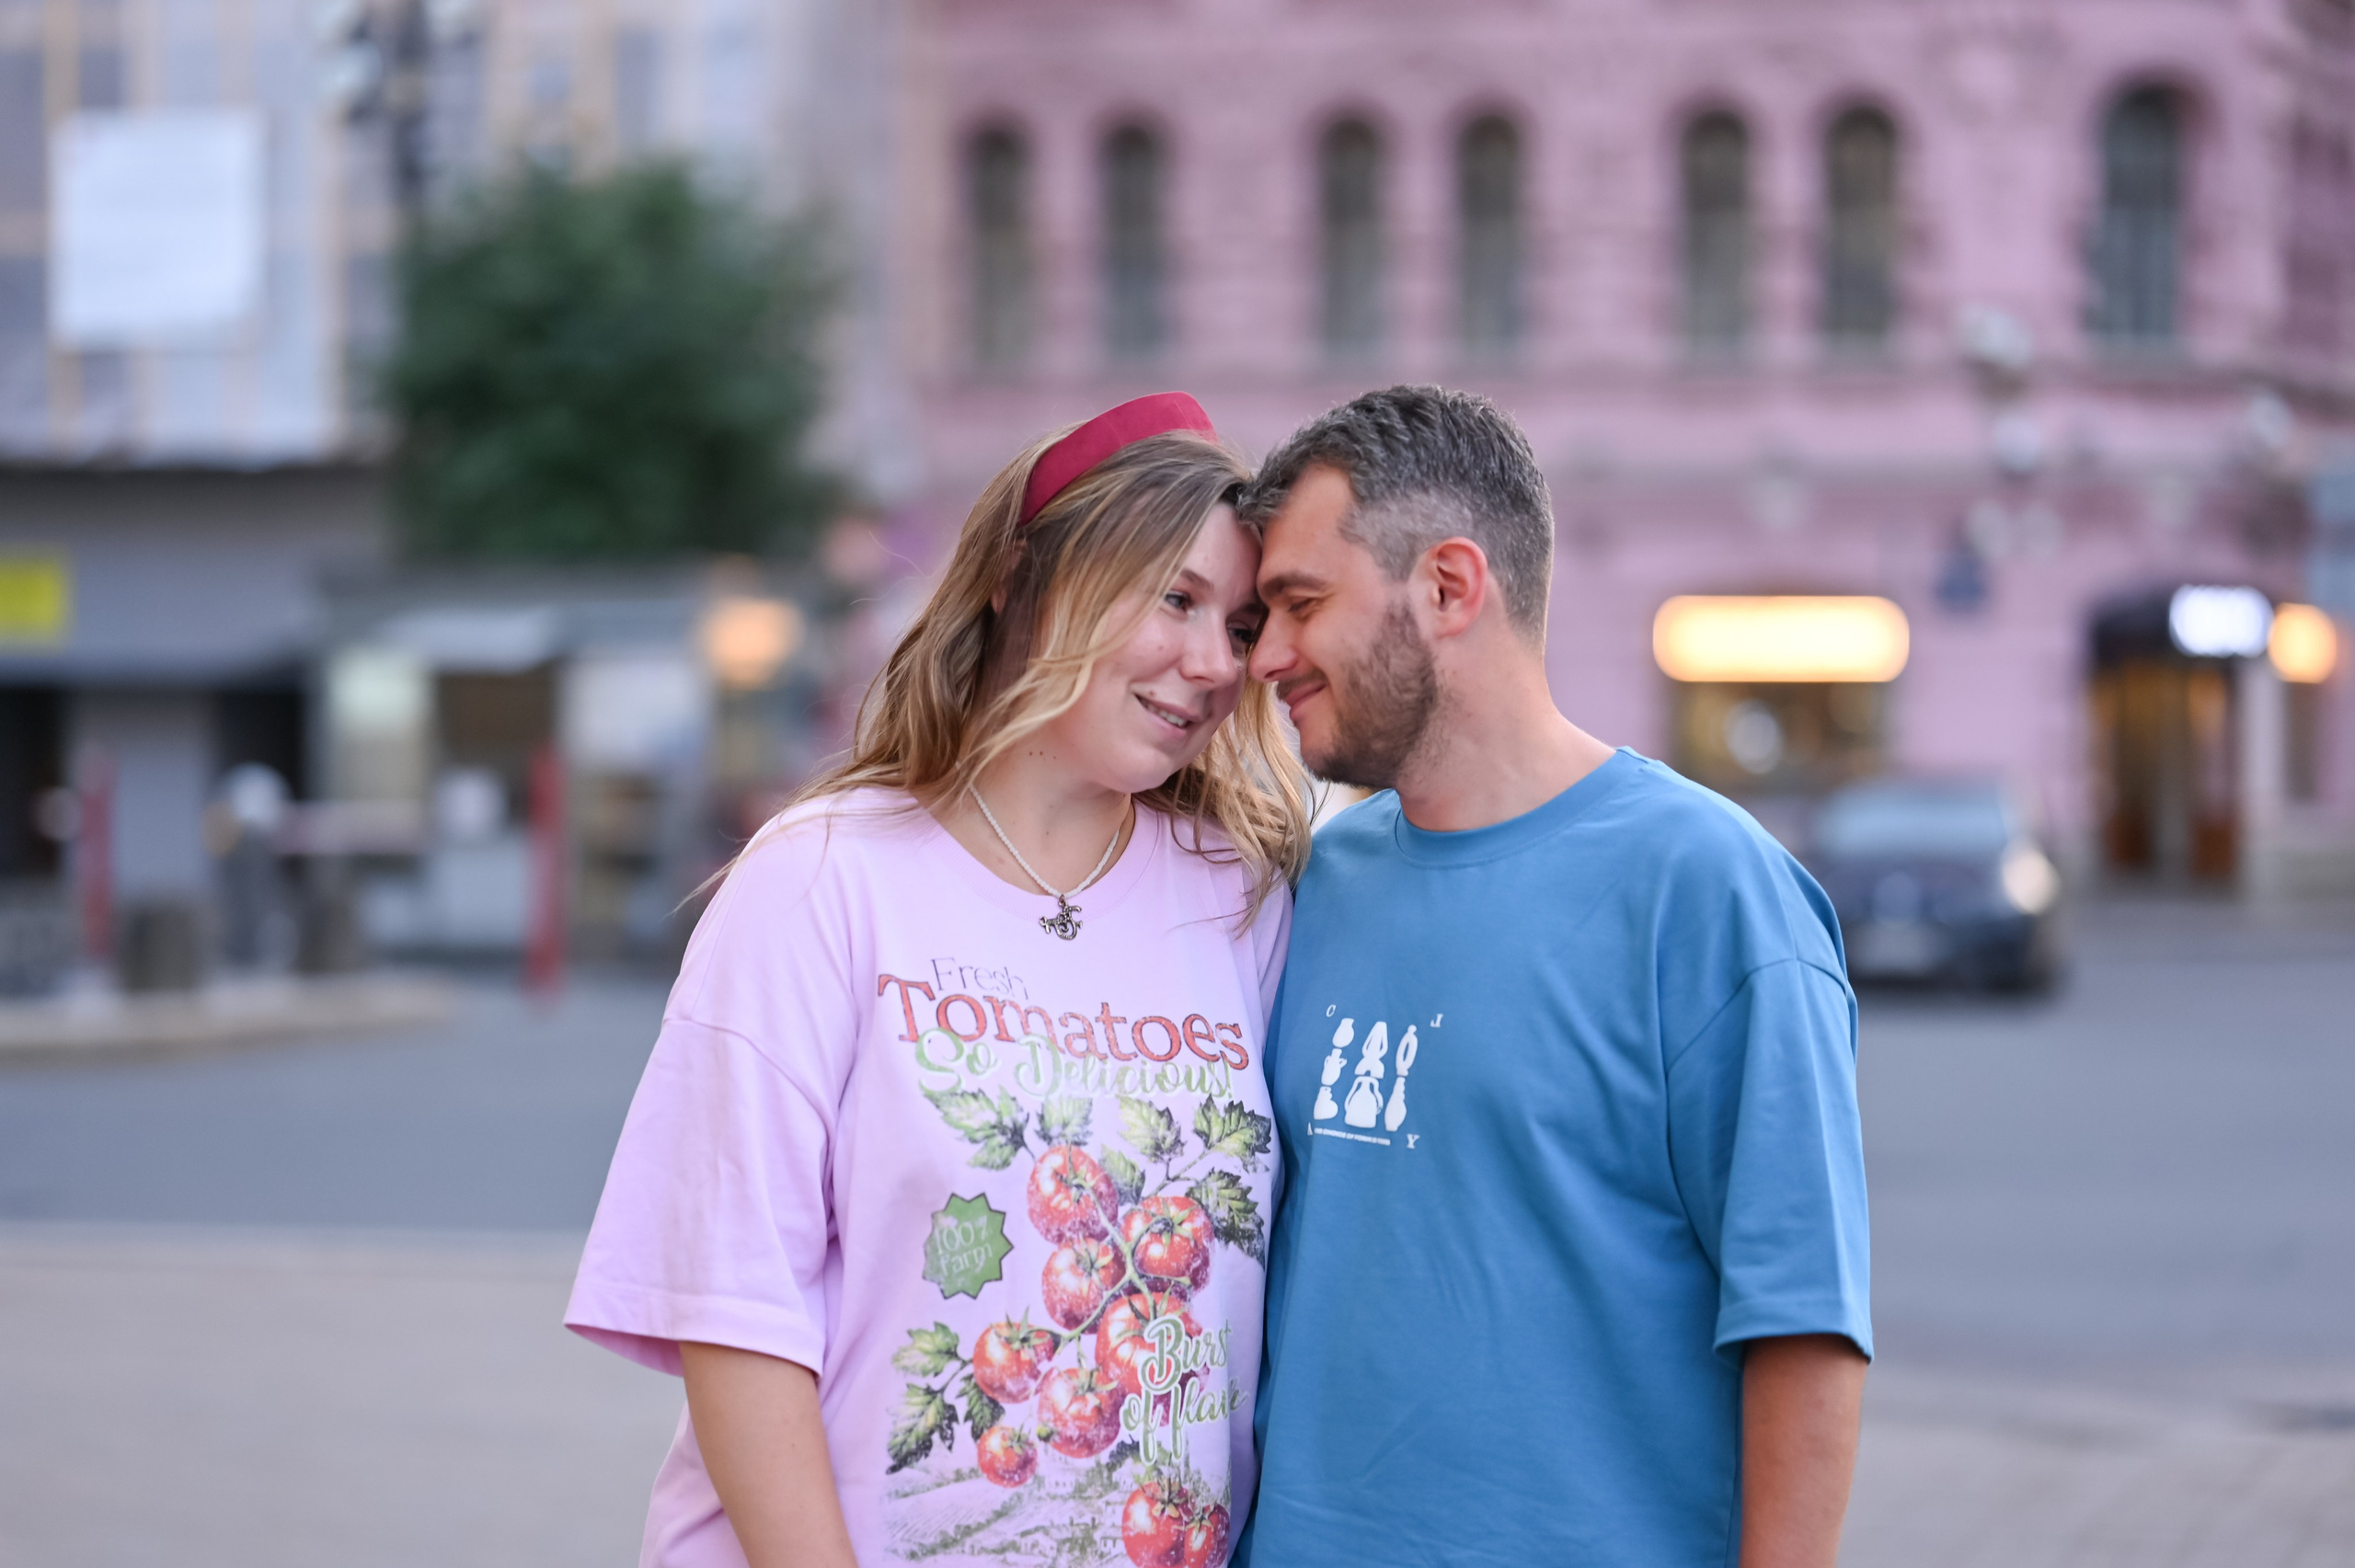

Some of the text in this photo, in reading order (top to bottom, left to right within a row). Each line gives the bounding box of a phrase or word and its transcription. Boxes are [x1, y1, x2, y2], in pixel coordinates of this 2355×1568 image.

[931, 956, 1028, 1000] Fresh
[878, 973, 1249, 1070] Tomatoes
[915, 1027, 999, 1094] So
[1139, 1316, 1234, 1394] Burst
[1120, 1386, 1164, 1464] of
